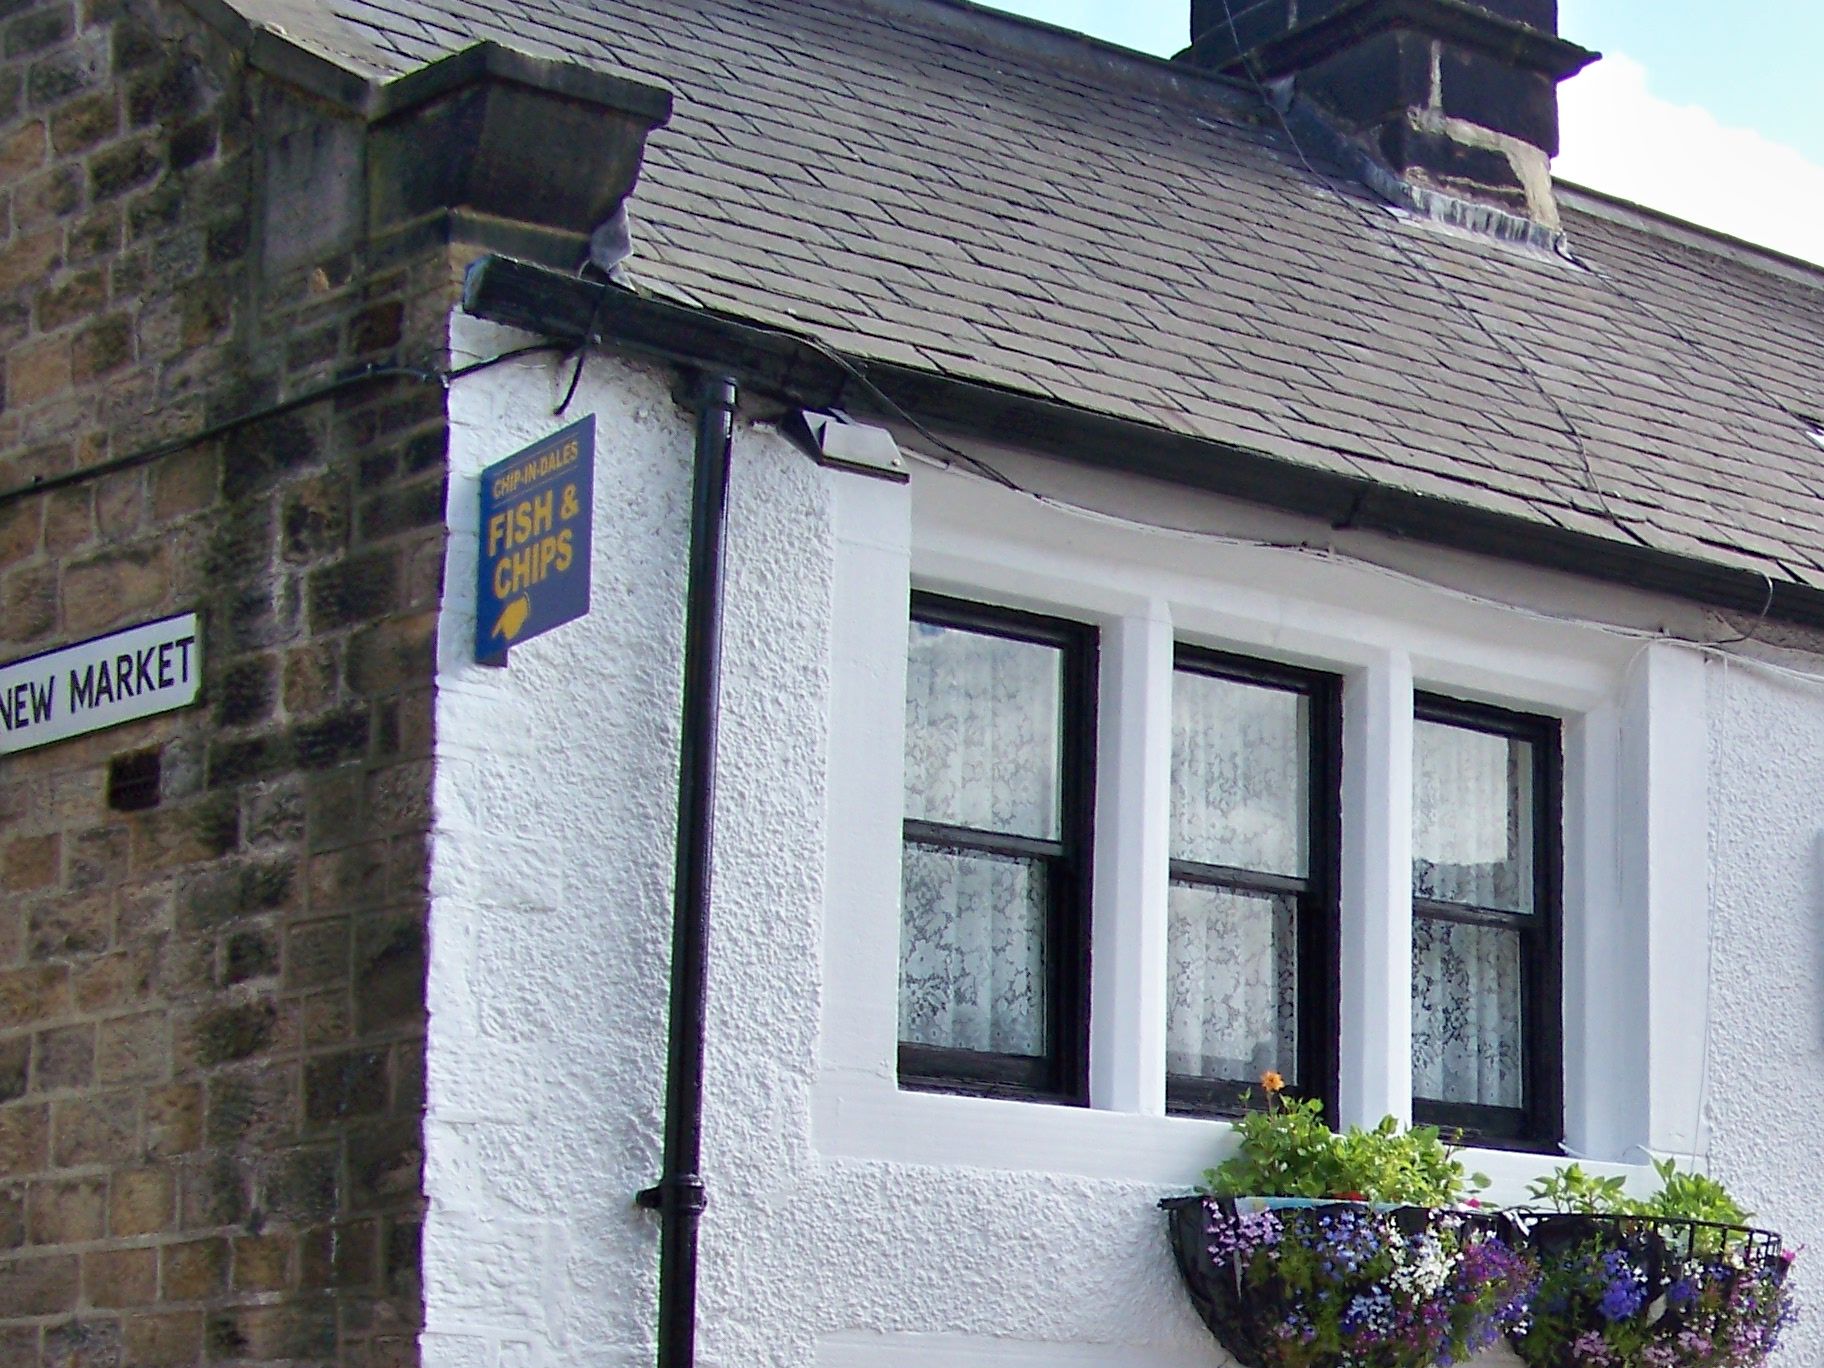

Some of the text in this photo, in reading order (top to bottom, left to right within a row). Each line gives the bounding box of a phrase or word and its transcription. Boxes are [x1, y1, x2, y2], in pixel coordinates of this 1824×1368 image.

[488, 483, 580, 558] FISH &
[493, 528, 574, 600] CHIPS
[0, 635, 196, 731] NEW MARKET
